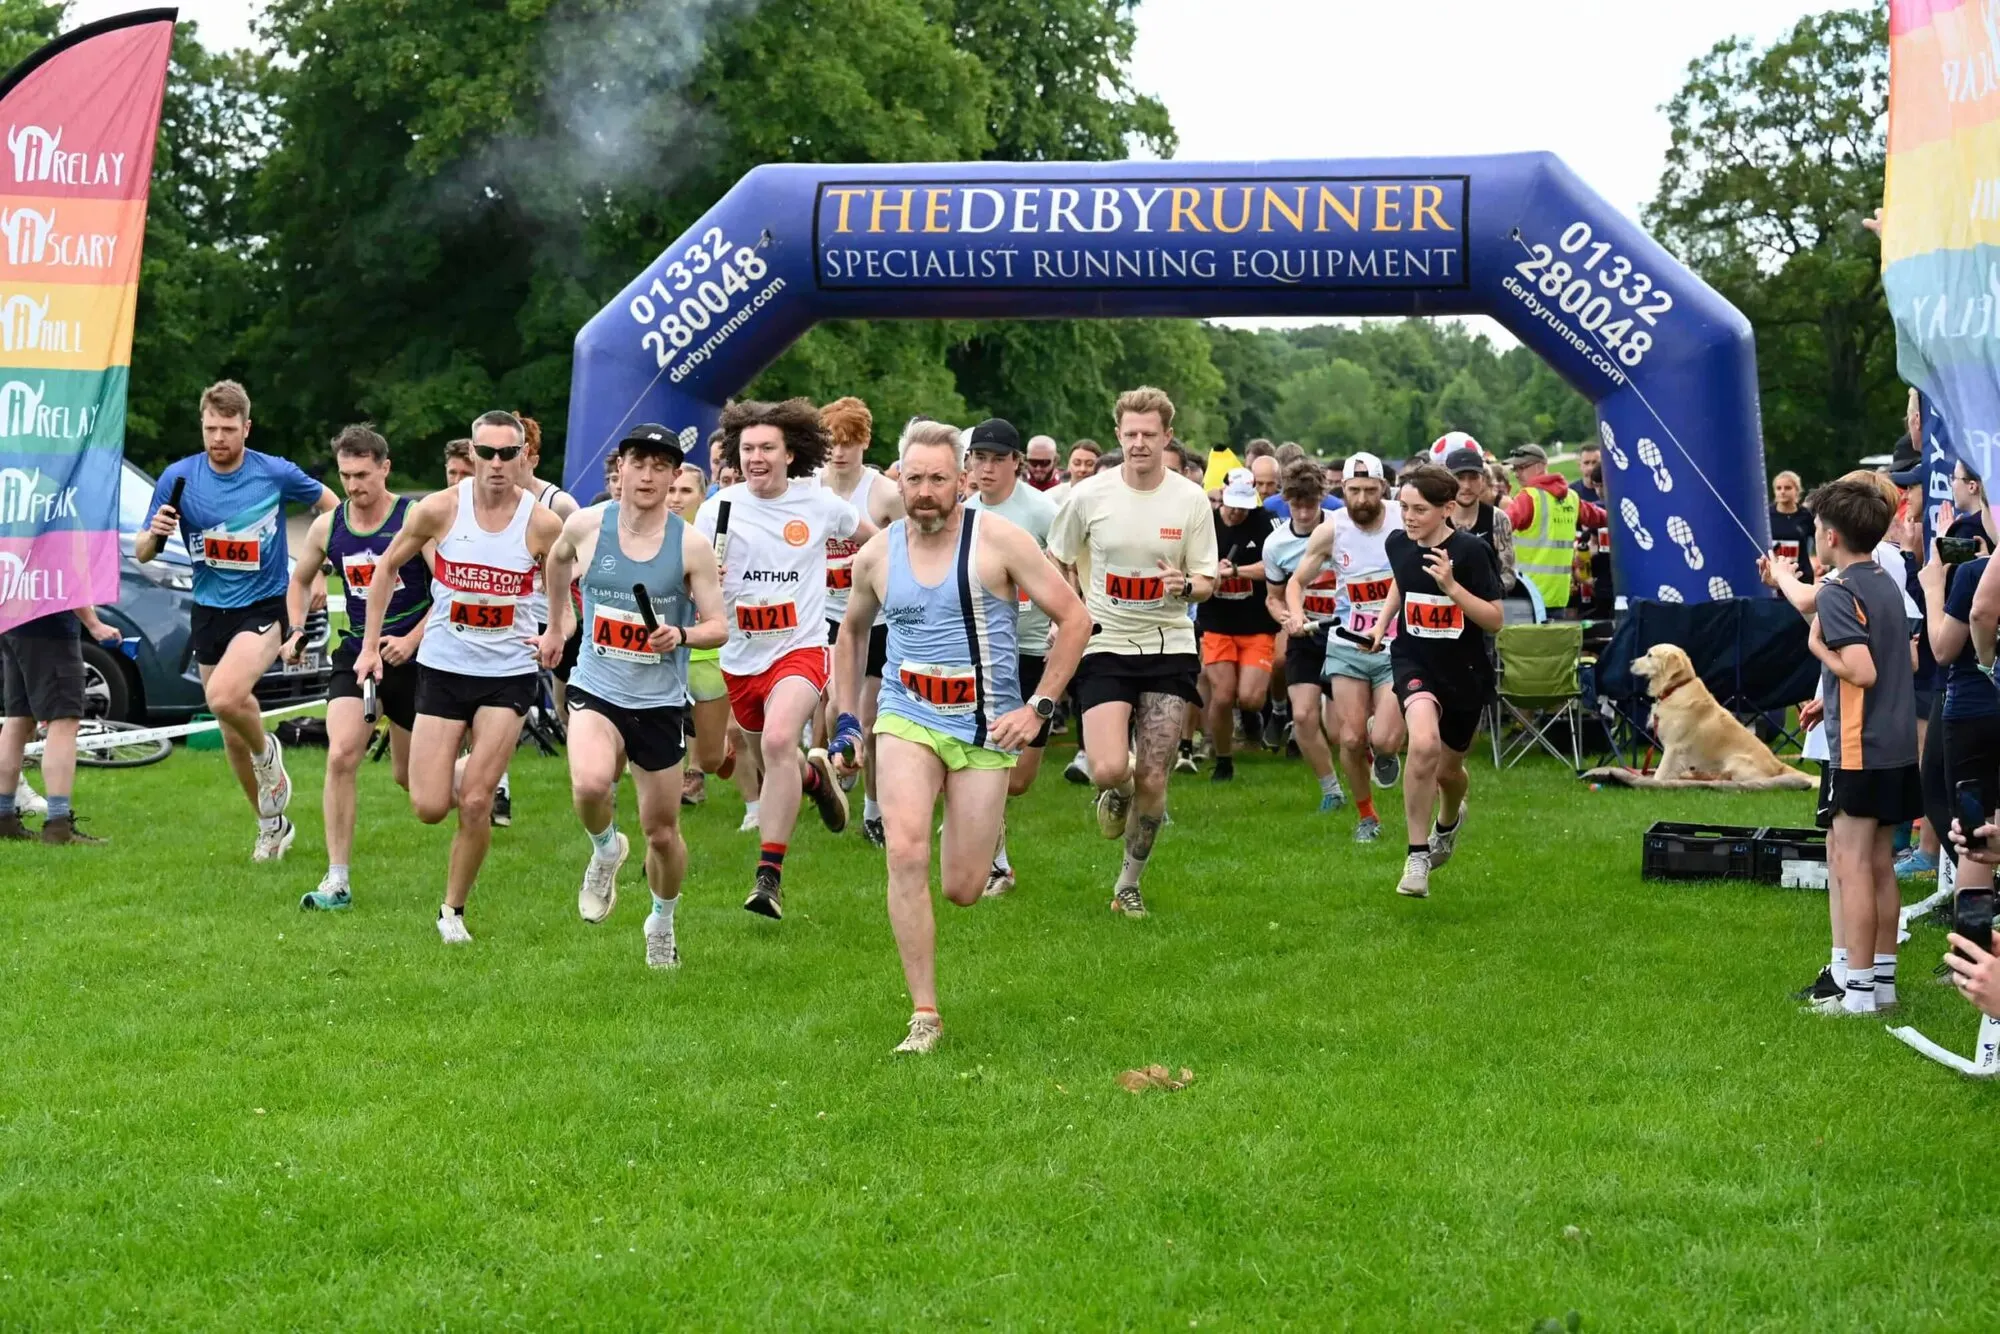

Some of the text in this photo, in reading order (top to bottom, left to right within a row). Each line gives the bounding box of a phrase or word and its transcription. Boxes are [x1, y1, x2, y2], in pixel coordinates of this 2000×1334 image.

[53, 150, 125, 186] RELAY
[46, 232, 118, 268] SCARY
[825, 247, 1457, 284] SPECIALIST RUNNING EQUIPMENT
[630, 227, 732, 324] 01332
[1560, 221, 1673, 326] 01332
[641, 247, 768, 369] 280048
[1515, 243, 1653, 367] 280048
[669, 276, 787, 383] derbyrunner.com
[1502, 276, 1627, 386] derbyrunner.com
[37, 402, 100, 438] RELAY
[30, 486, 79, 524] PEAK
[210, 540, 220, 558] A
[227, 543, 249, 561] 66
[20, 566, 68, 600] HELL
[352, 567, 365, 587] A
[445, 562, 524, 586] ILKESTON
[493, 584, 521, 594] CLUB
[742, 571, 799, 582] ARTHUR
[590, 587, 677, 605] TEAM DERB UNNER
[1353, 580, 1387, 602] A 80
[456, 605, 502, 627] A 53
[742, 605, 790, 630] A121
[1354, 614, 1365, 632] D
[1412, 604, 1424, 626] A
[1429, 607, 1453, 628] 44
[597, 620, 649, 651] A 99
[909, 674, 968, 703] A112
